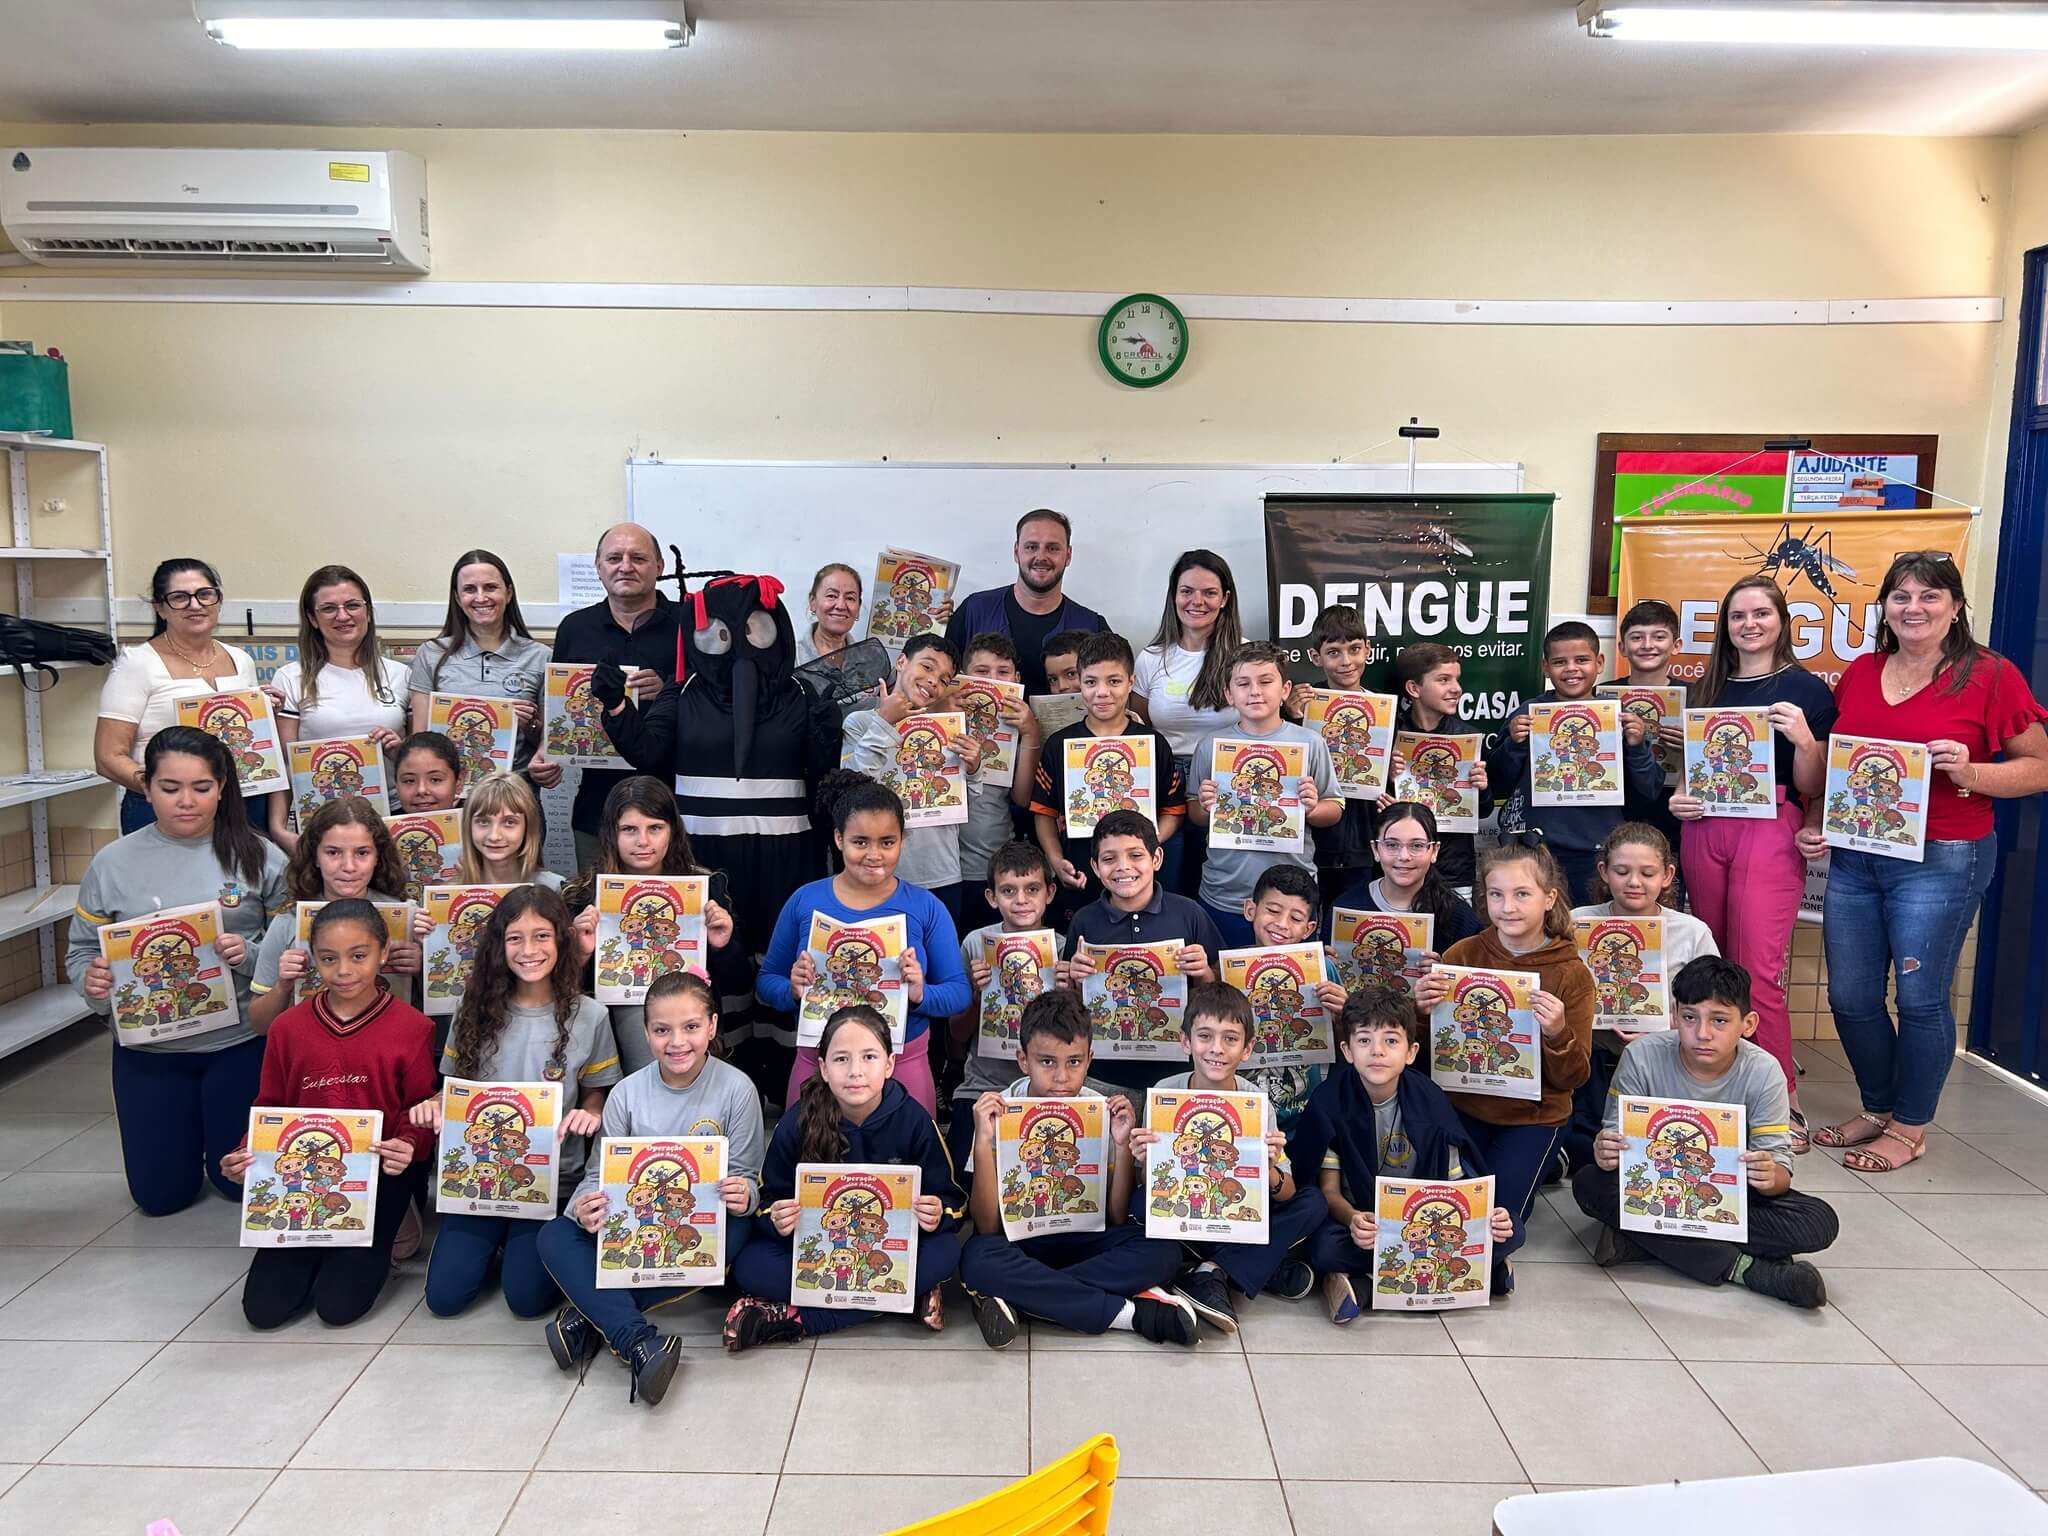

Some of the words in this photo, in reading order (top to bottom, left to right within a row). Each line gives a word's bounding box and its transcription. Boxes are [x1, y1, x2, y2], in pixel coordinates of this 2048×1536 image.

[1128, 310, 1135, 318] 11
[1141, 304, 1150, 314] 12
[1798, 456, 1888, 472] AJUDANTE
[1478, 640, 1524, 657] evitar.
[1458, 691, 1520, 720] CASA
[302, 1074, 368, 1090] Superstar
